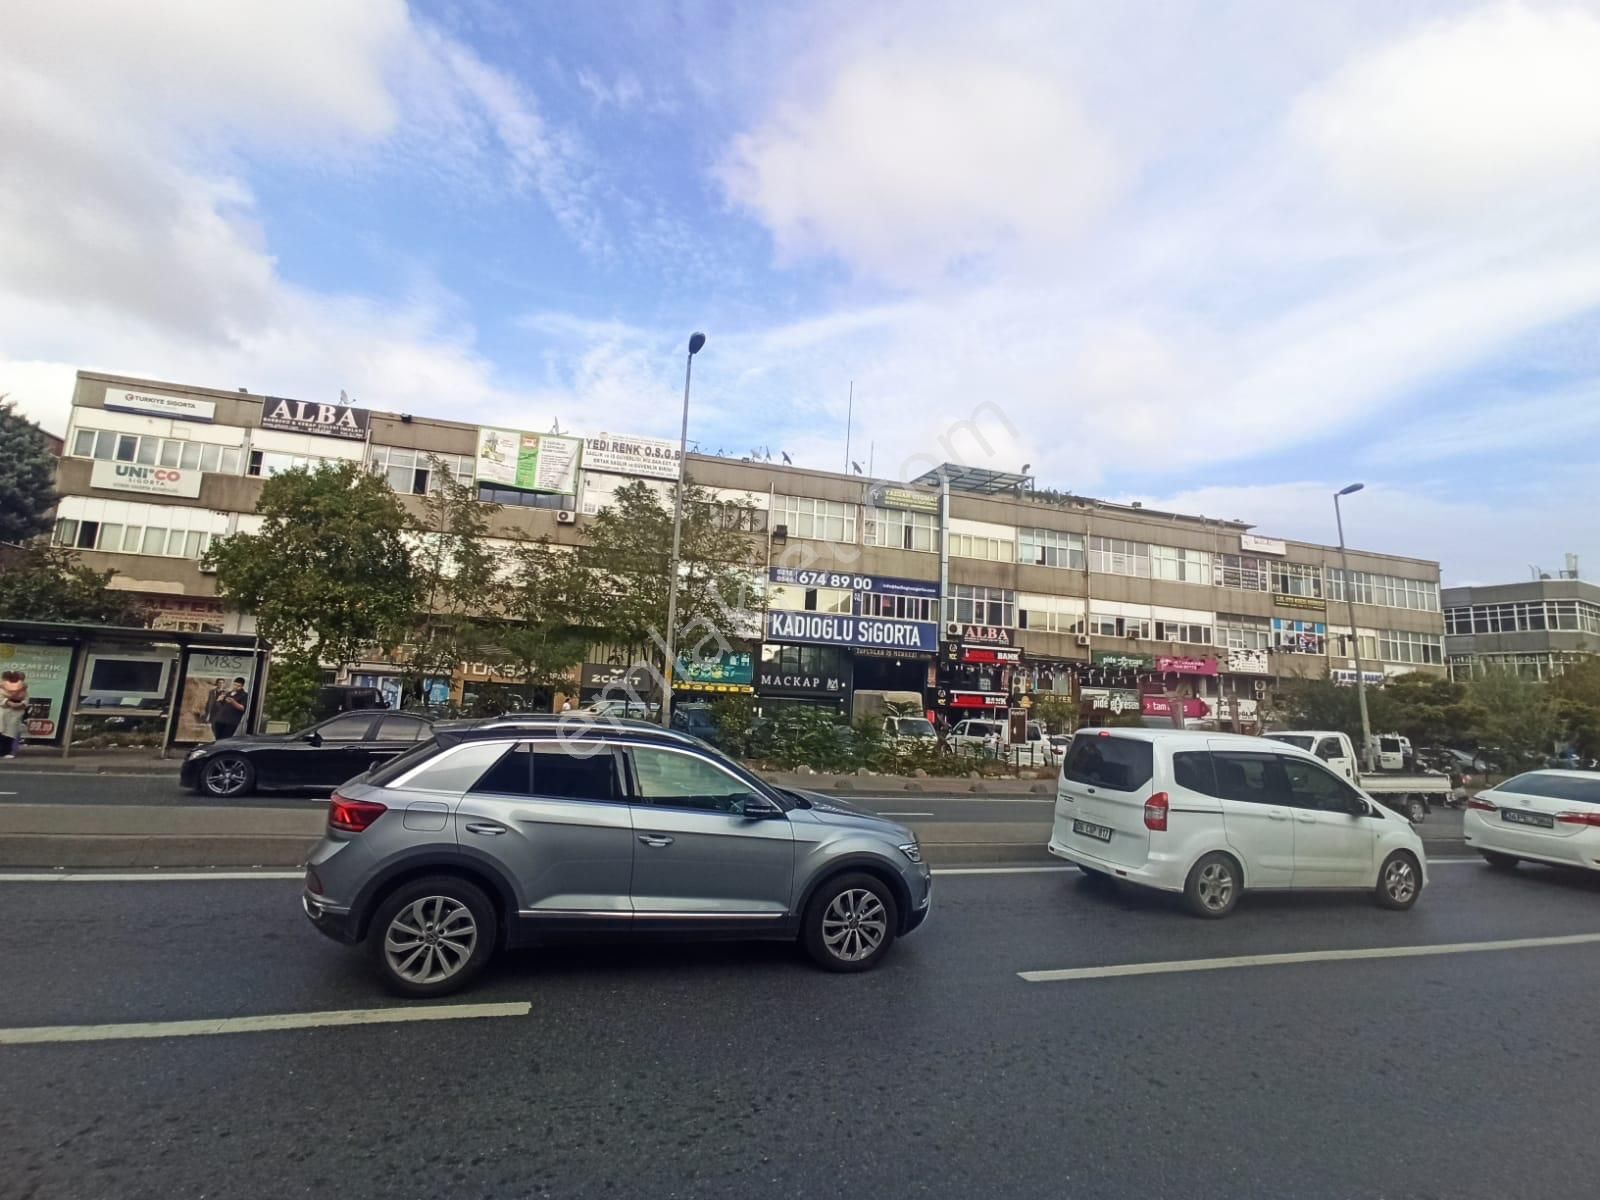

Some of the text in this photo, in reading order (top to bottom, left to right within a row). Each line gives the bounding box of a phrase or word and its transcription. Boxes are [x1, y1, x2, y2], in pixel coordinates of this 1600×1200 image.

[269, 399, 358, 428] ALBA
[612, 441, 641, 456] RENK
[799, 571, 826, 586] 674
[830, 574, 850, 588] 89
[853, 576, 872, 591] 00
[772, 613, 853, 641] KADIOĞLU
[964, 625, 1009, 640] ALBA
[203, 655, 242, 670] M&S
[760, 674, 820, 688] MACKAP
